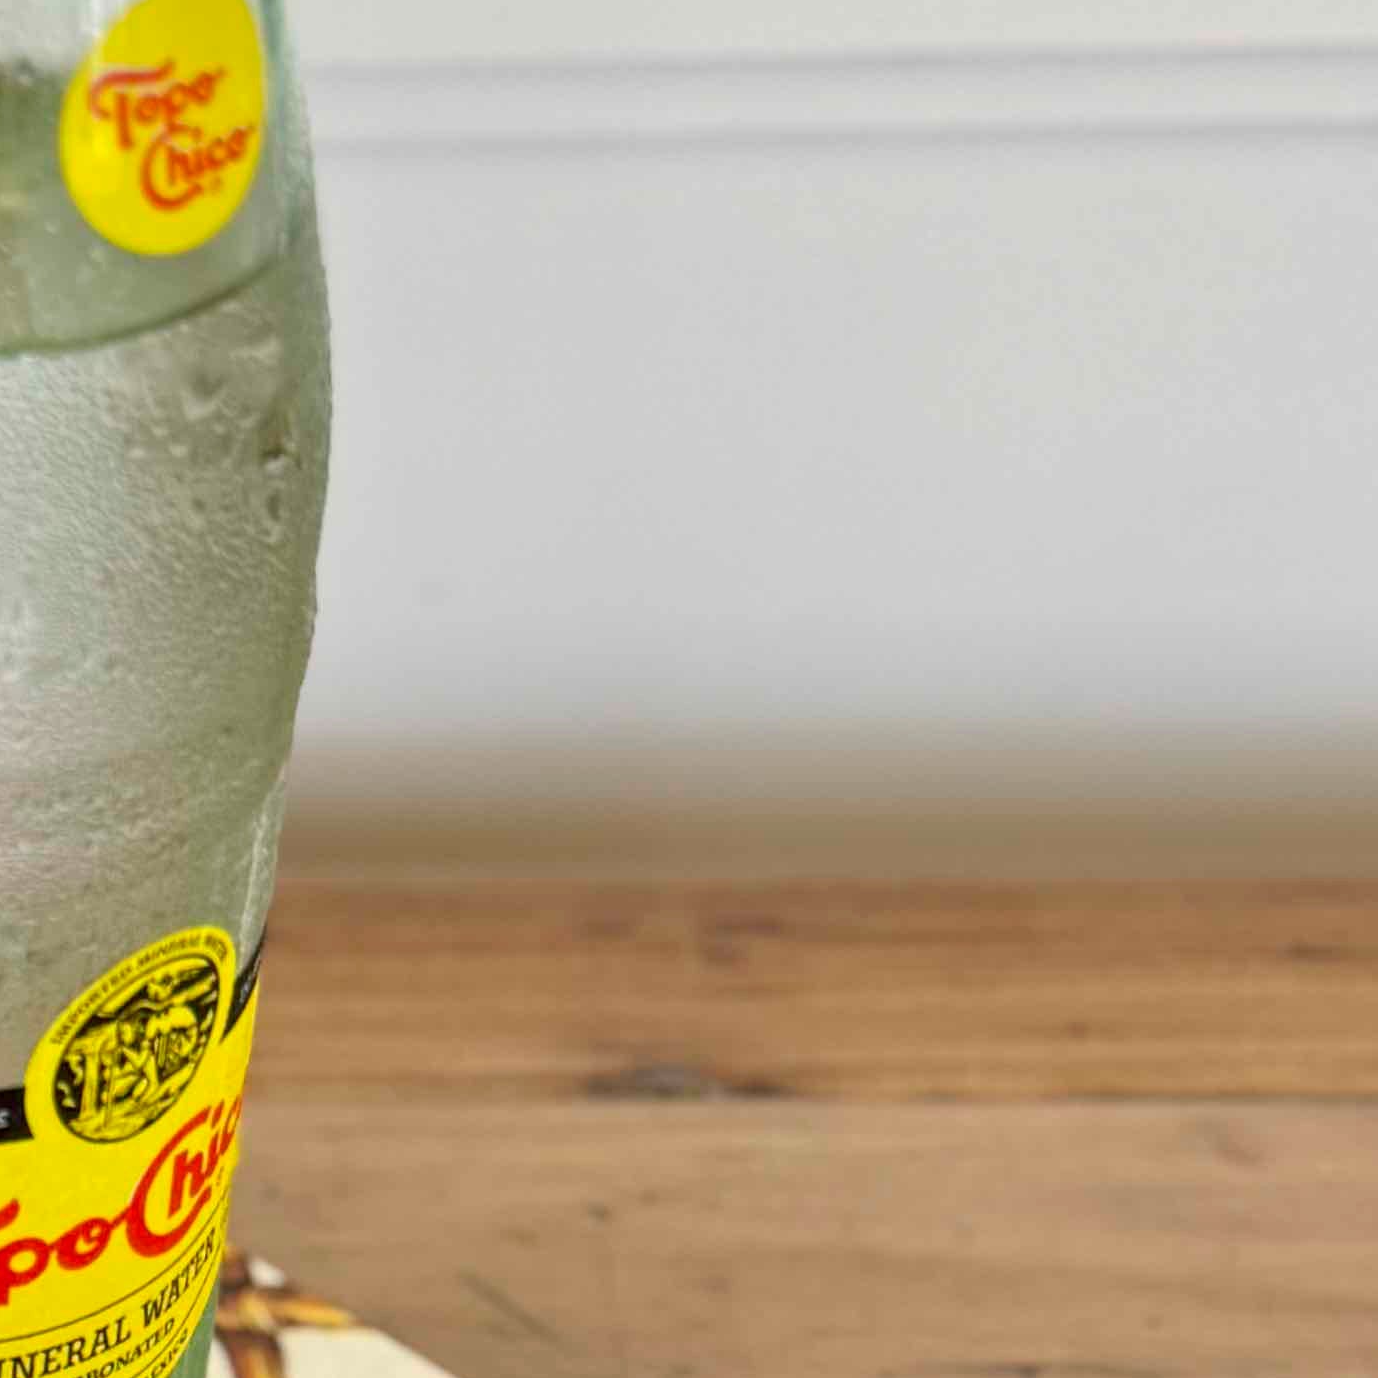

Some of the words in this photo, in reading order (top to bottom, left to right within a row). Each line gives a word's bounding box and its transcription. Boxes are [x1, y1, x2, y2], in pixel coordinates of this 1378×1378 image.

[87, 57, 227, 151] Topo
[140, 121, 256, 211] Chico
[126, 1094, 243, 1258] Chic
[141, 1227, 216, 1328] WATER
